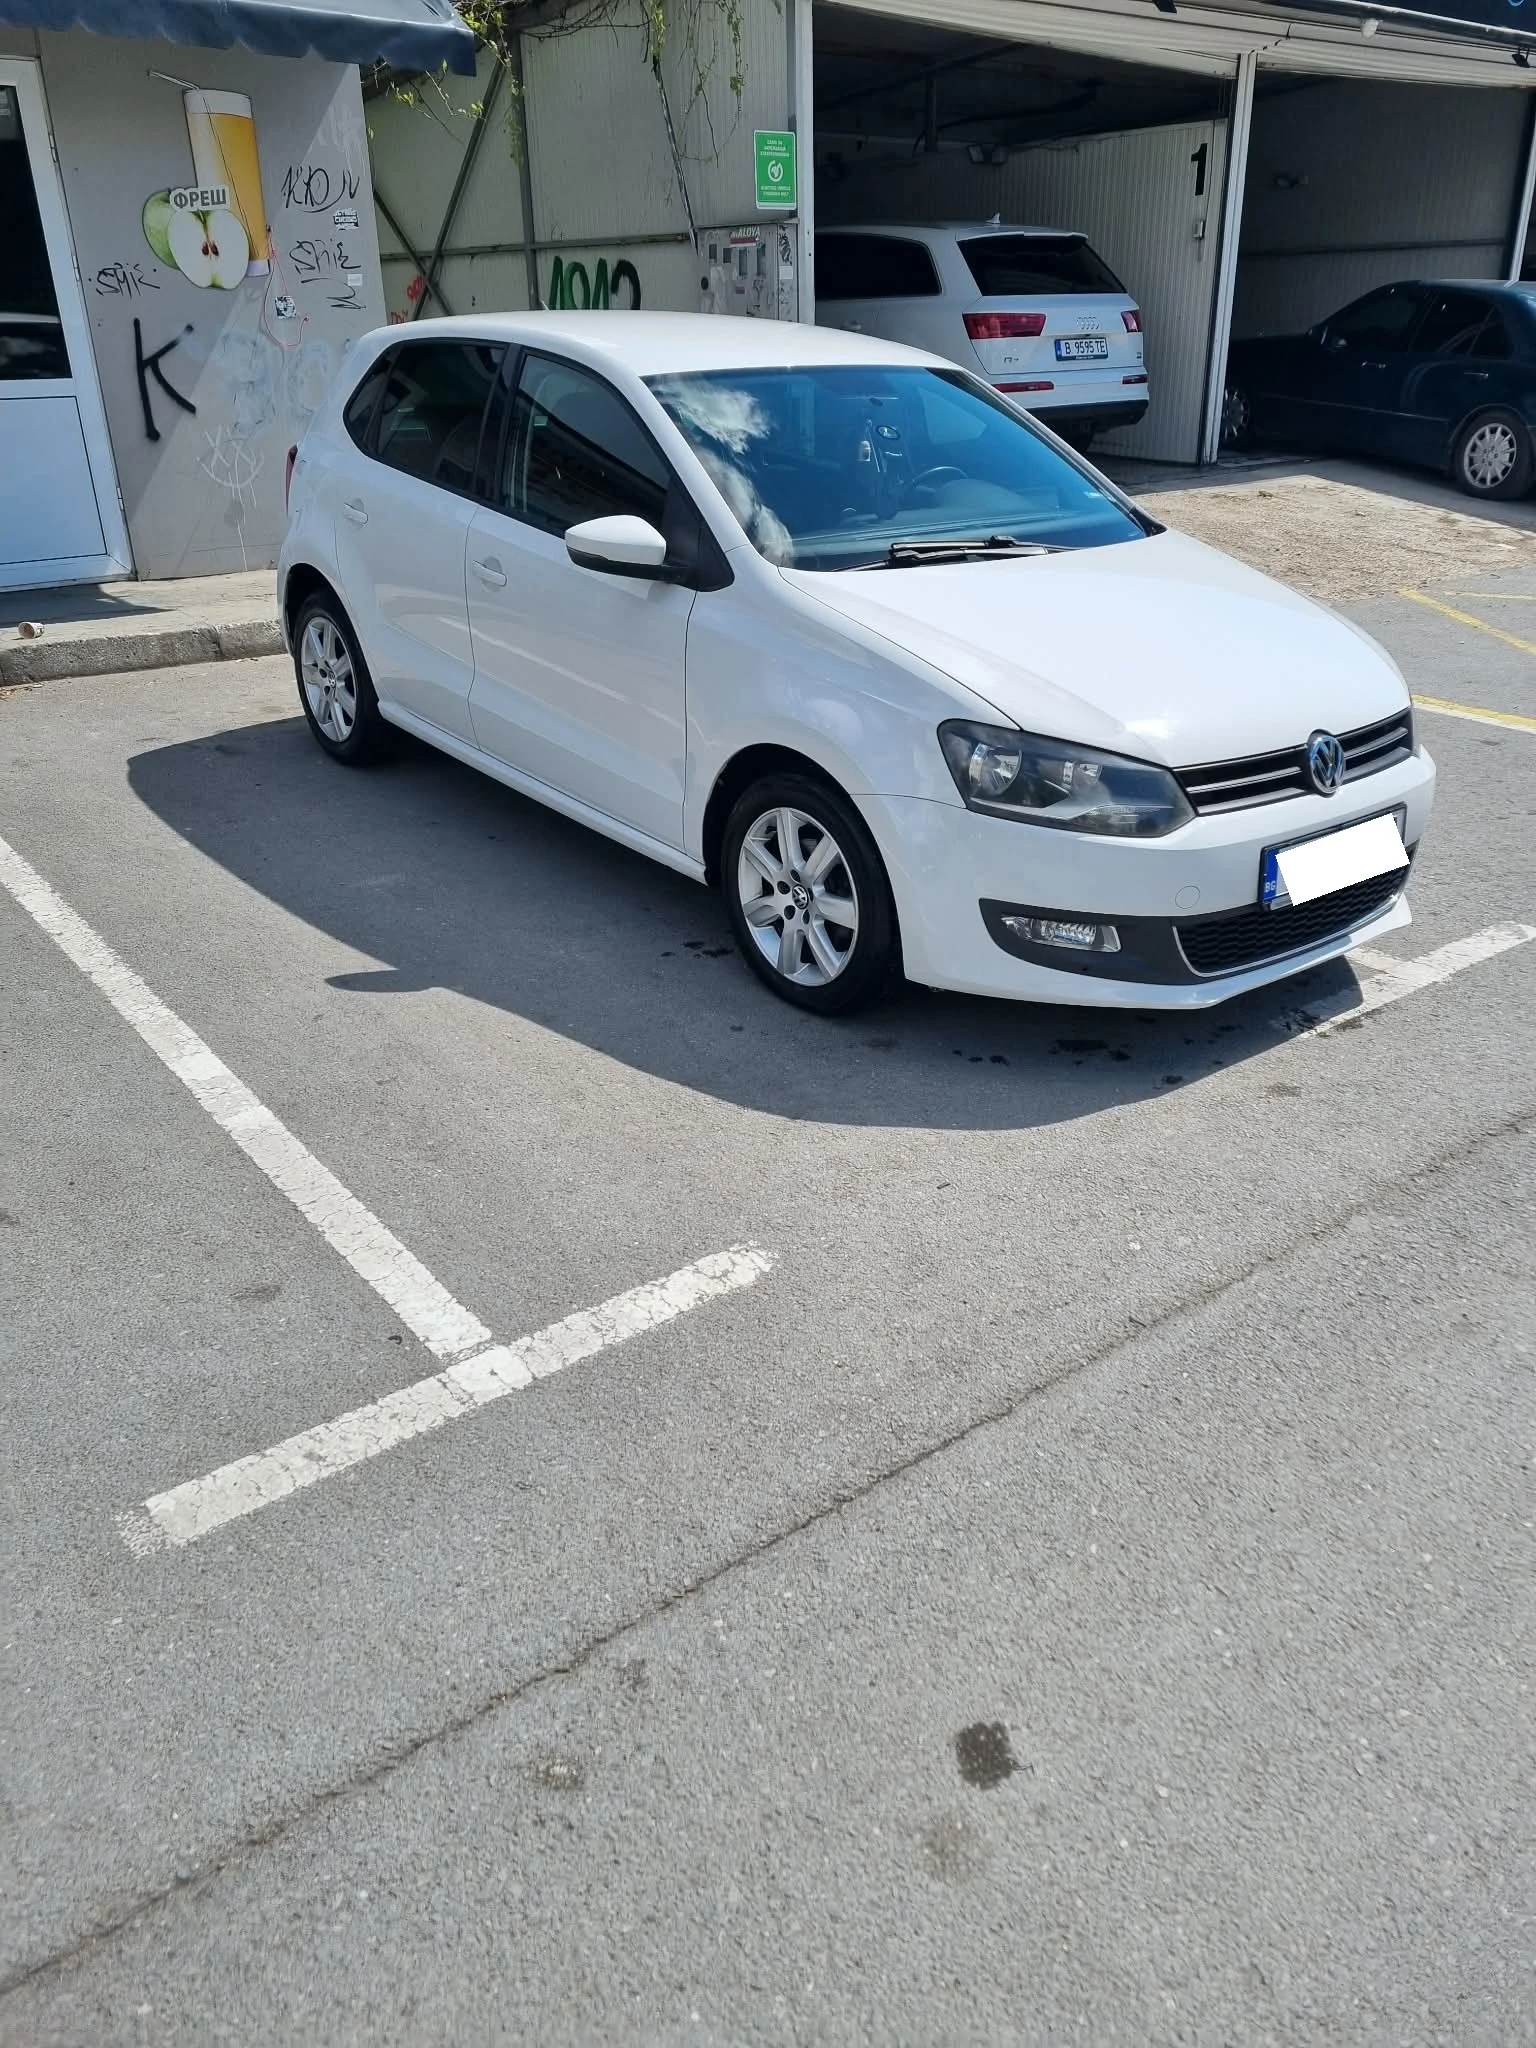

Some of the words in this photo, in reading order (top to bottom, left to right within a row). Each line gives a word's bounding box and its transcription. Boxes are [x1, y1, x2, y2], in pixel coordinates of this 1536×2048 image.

[1191, 143, 1208, 196] 1
[173, 188, 227, 209] ФРЕШ
[1064, 342, 1072, 355] B
[1074, 341, 1095, 355] 9595
[1095, 340, 1106, 353] TE
[133, 318, 197, 441] K
[1265, 881, 1277, 894] BG
